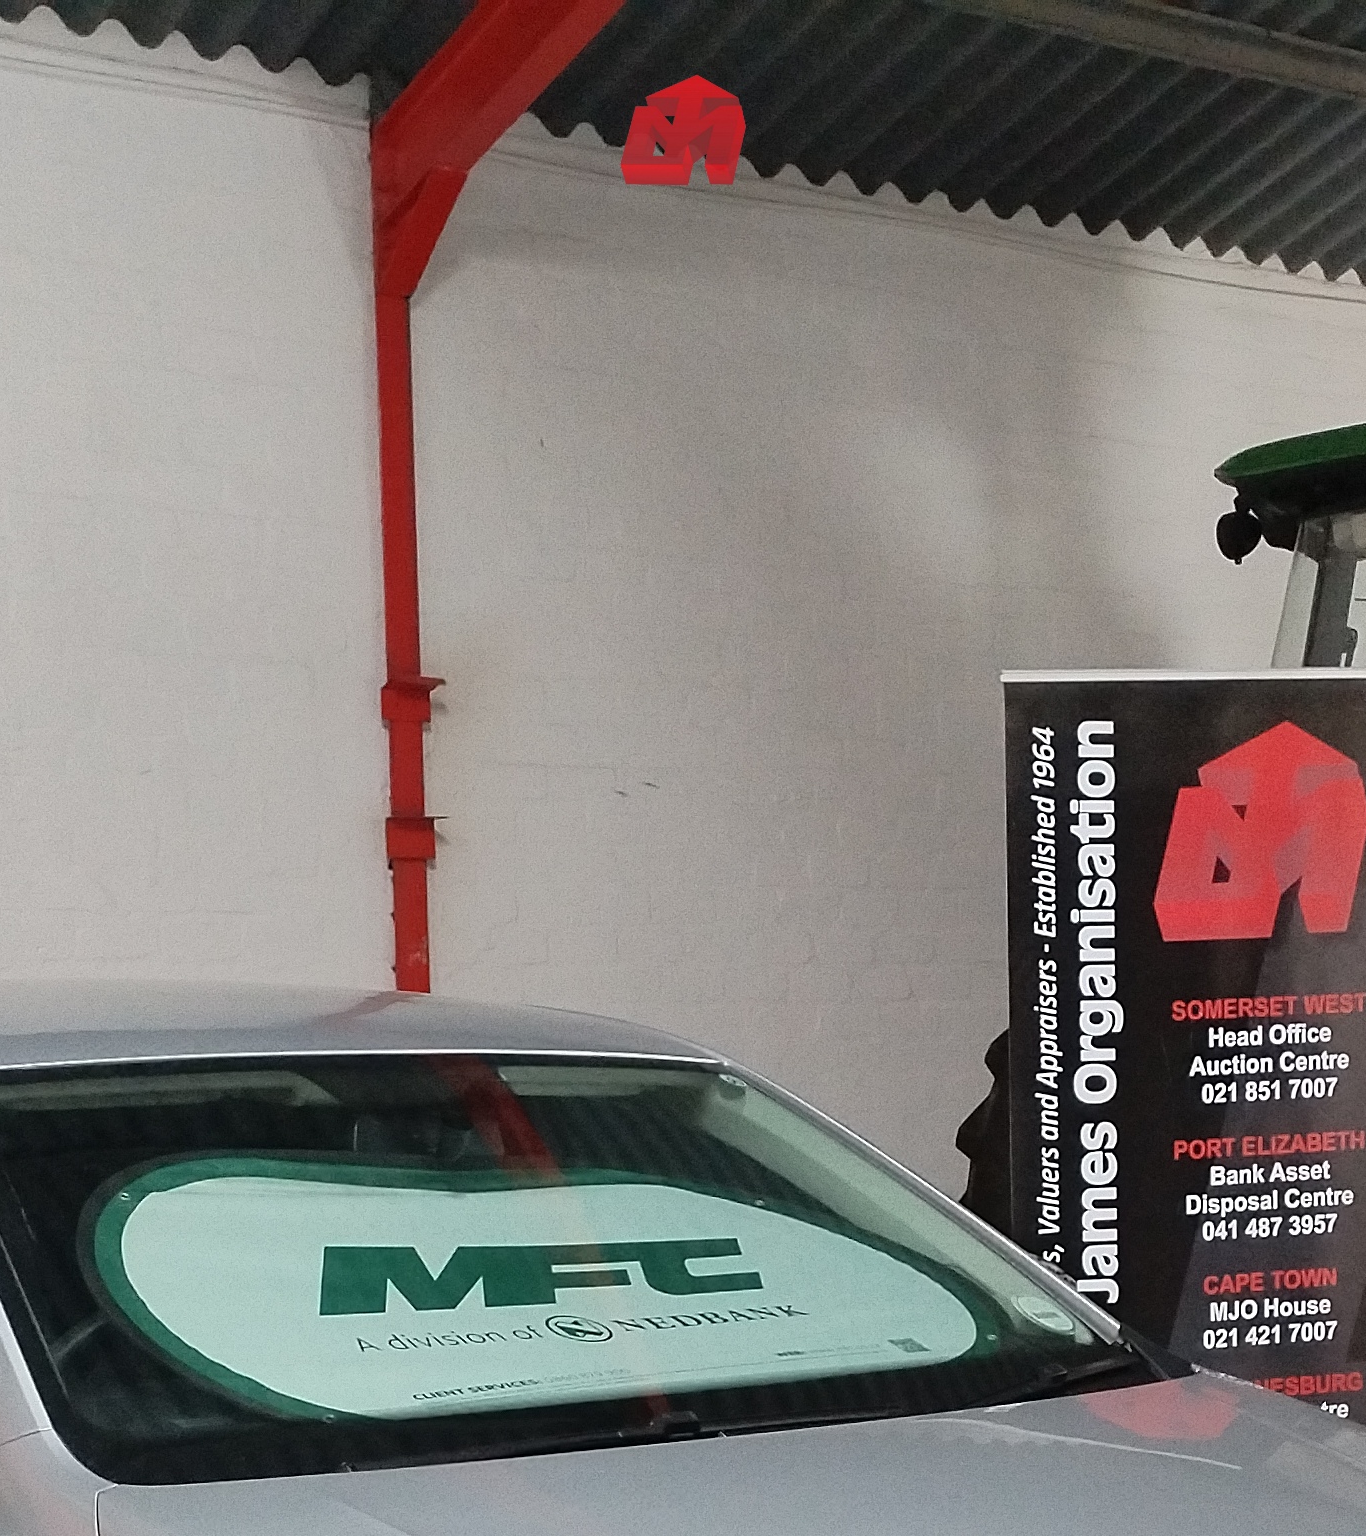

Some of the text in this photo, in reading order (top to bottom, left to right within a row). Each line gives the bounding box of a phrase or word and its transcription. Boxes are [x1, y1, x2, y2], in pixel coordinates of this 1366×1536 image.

[1032, 726, 1056, 788] 1964
[1031, 795, 1056, 938] Established
[1070, 720, 1125, 1304] James Organisation
[1171, 992, 1366, 1021] SOMERSET WEST
[1034, 959, 1063, 1089] Appraisers
[1208, 1022, 1332, 1048] Head Office
[1189, 1050, 1350, 1077] Auction Centre
[1201, 1077, 1338, 1104] 021 851 7007
[1035, 1093, 1059, 1141] and
[1173, 1130, 1366, 1161] PORT ELIZABETH
[1210, 1160, 1331, 1186] Bank Asset
[1036, 1147, 1060, 1235] Valuers
[1185, 1187, 1354, 1218] Disposal Centre
[1202, 1213, 1338, 1241] 041 487 3957
[319, 1238, 763, 1316] MFC
[1203, 1267, 1338, 1295] CAPE TOWN
[1210, 1297, 1331, 1322] MJO House
[357, 1304, 809, 1353] A division of NEDBANK
[1202, 1320, 1338, 1349] 021 421 7007
[413, 1387, 465, 1401] CLIENT
